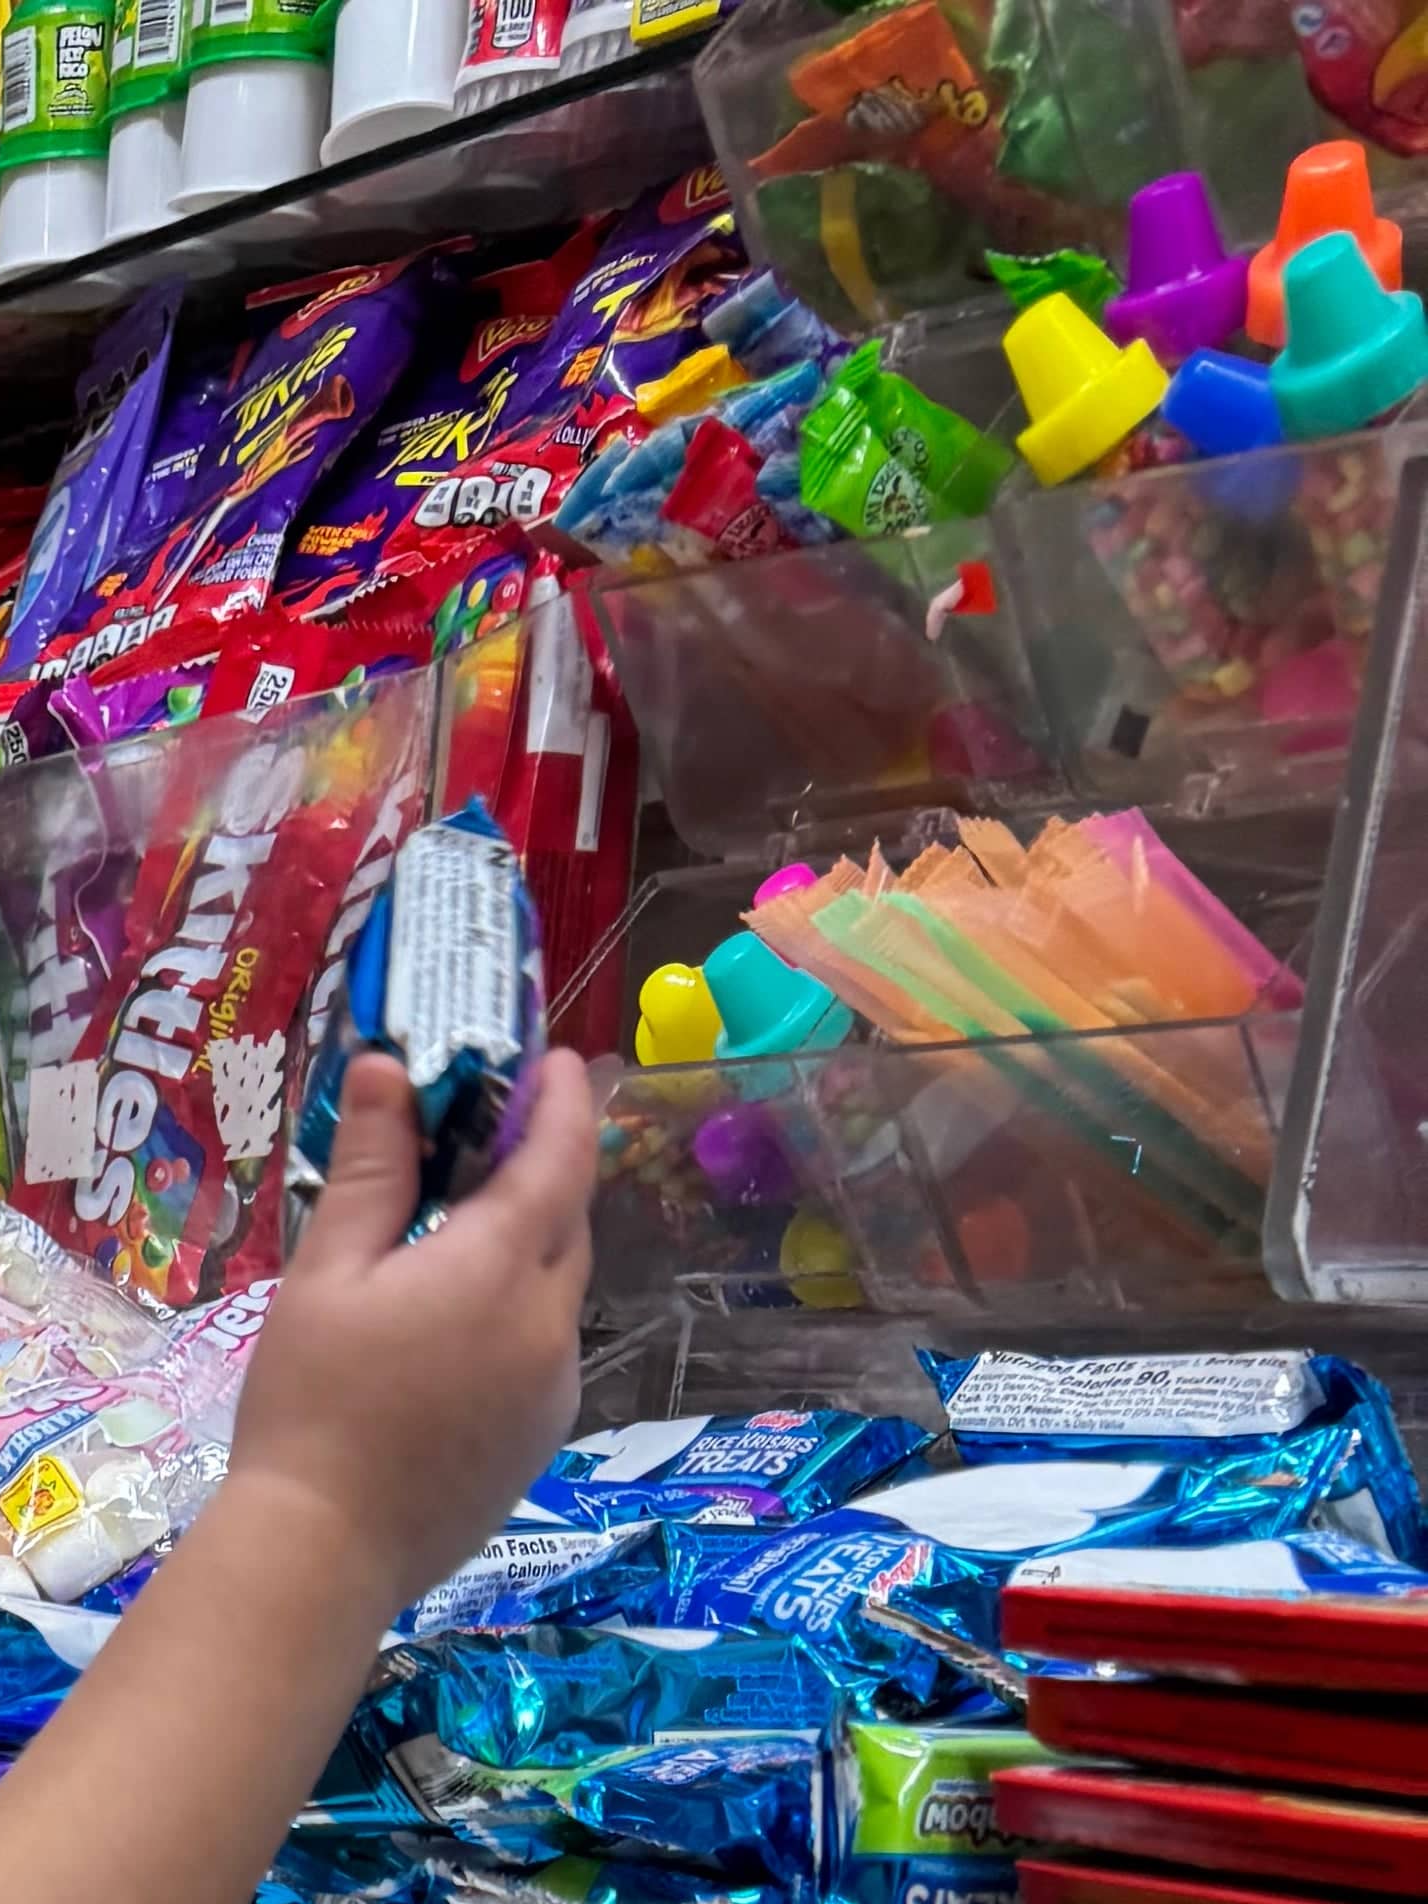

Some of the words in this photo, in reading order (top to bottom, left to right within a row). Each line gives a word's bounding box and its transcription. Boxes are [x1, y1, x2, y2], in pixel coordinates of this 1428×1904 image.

[691, 1435, 737, 1453] RICE
[739, 1431, 818, 1454] KRISPIES
[675, 1450, 799, 1475] TREATS
[506, 1537, 558, 1557] Facts
